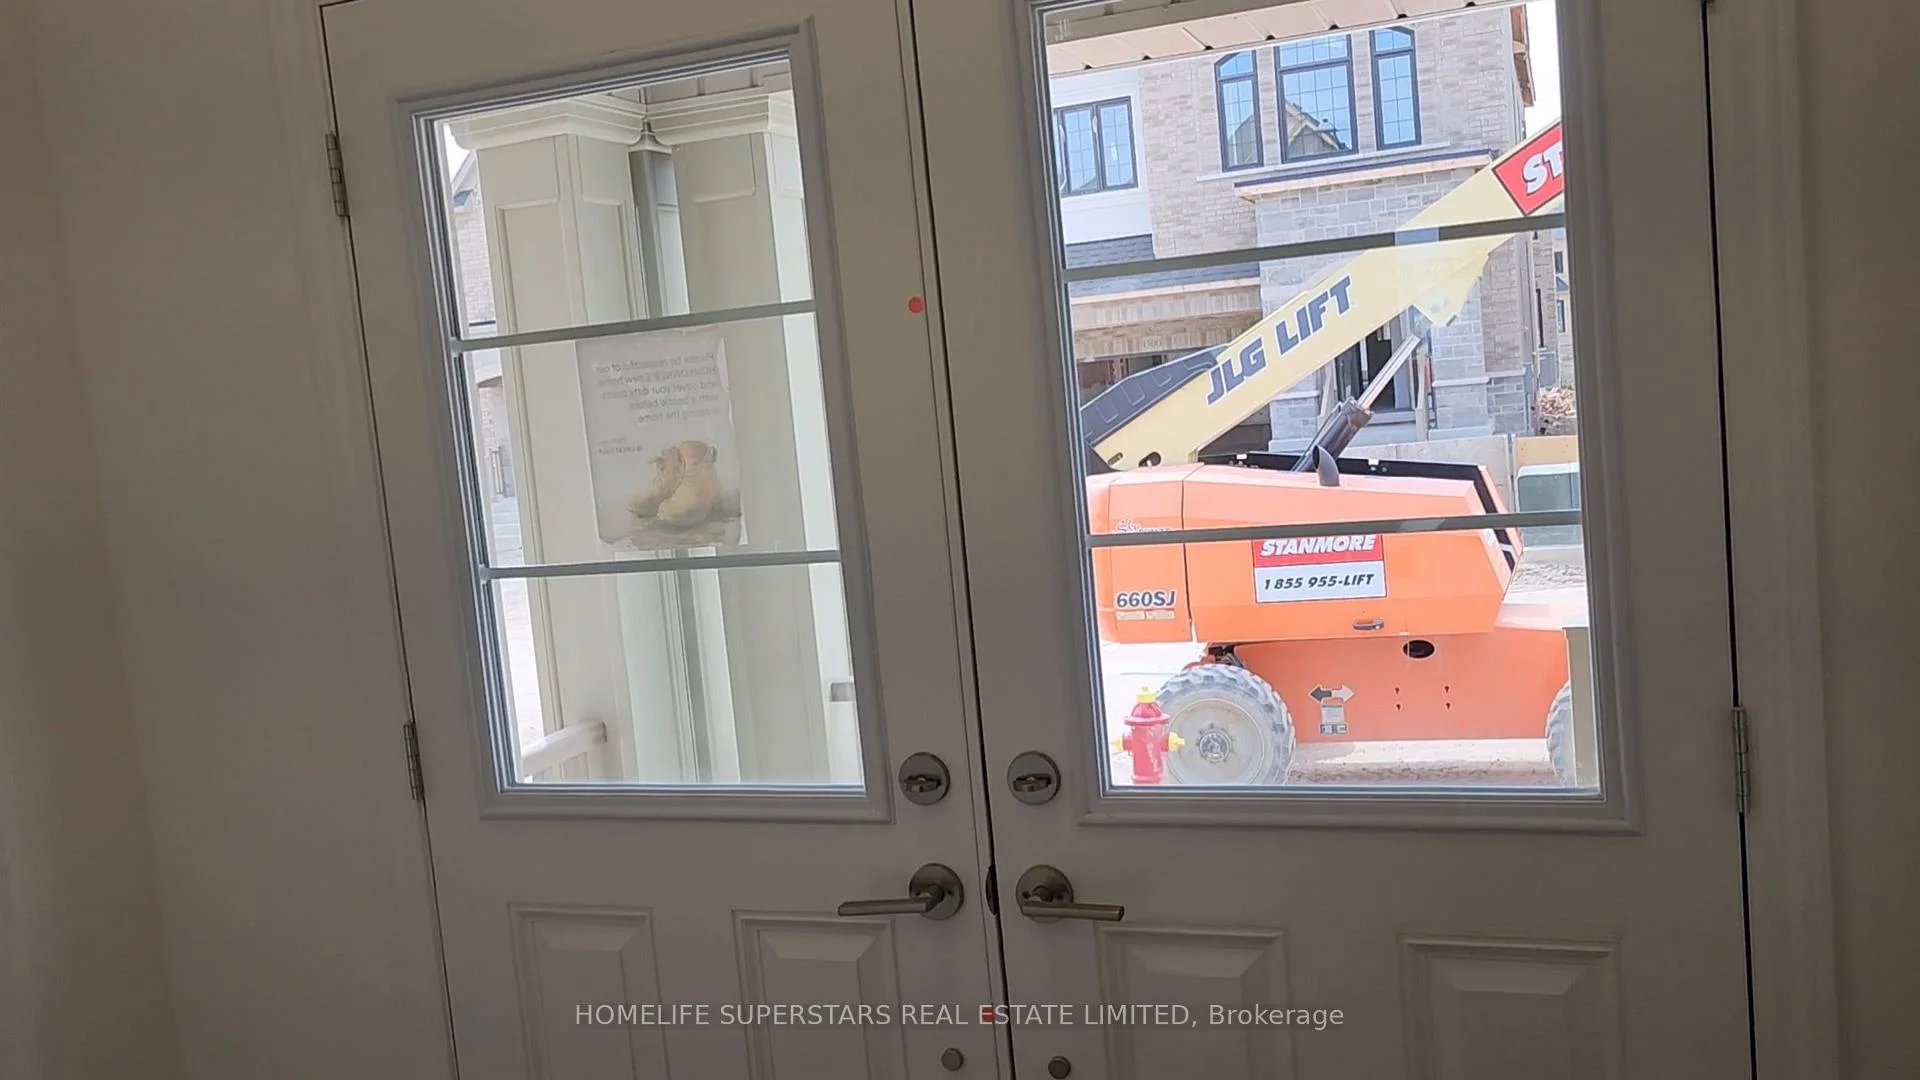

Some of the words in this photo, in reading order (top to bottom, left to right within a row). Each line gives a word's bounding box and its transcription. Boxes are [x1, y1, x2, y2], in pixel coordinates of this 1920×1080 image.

[1206, 336, 1267, 407] JLG
[1274, 273, 1352, 355] LIFT
[1260, 534, 1377, 556] STANMORE
[1264, 579, 1271, 590] 1
[1274, 577, 1303, 590] 855
[1308, 573, 1375, 588] 955-LIFT
[1116, 590, 1176, 608] 660SJ
